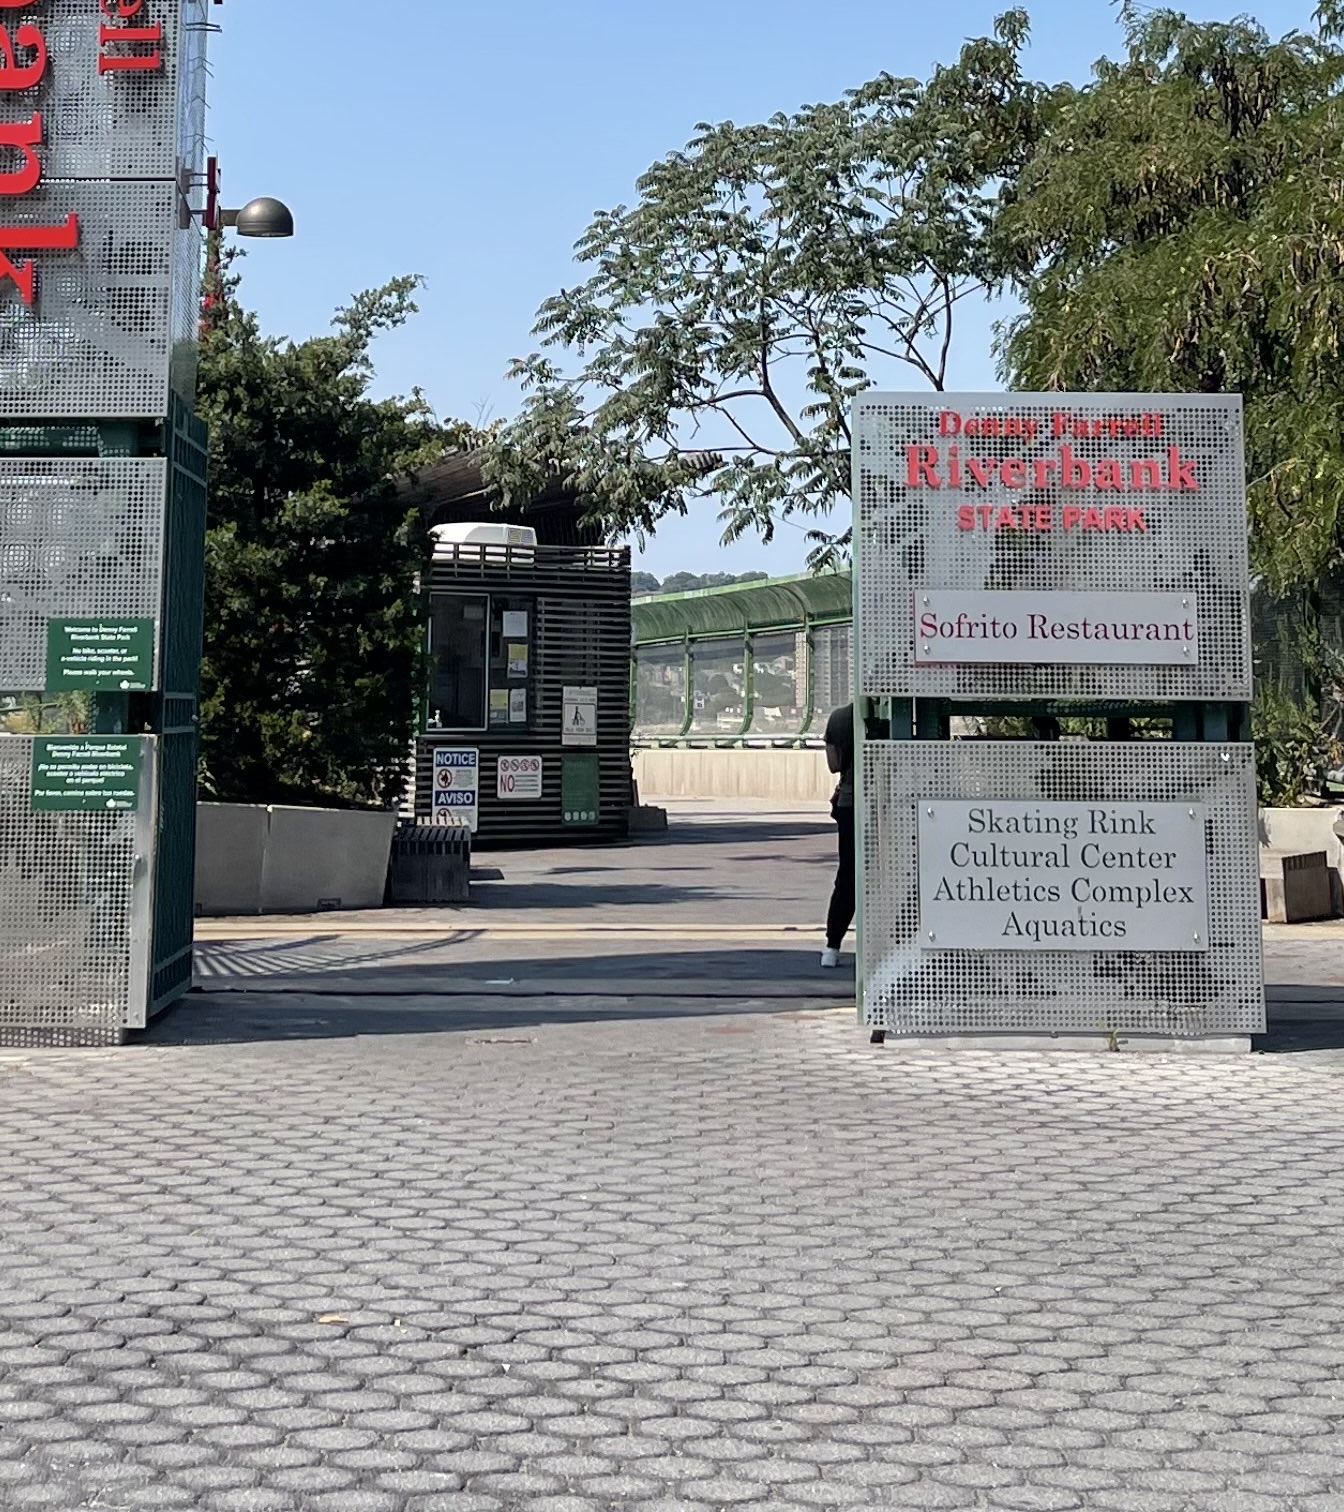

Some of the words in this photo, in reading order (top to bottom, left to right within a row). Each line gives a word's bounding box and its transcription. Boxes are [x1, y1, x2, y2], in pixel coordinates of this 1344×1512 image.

[939, 410, 1039, 440] Denny
[1051, 412, 1163, 437] Farrell
[902, 444, 1201, 489] Riverbank
[958, 505, 1052, 530] STATE
[1062, 505, 1148, 531] PARK
[920, 612, 1017, 639] Sofrito
[1027, 613, 1195, 641] Restaurant
[436, 753, 476, 765] NOTICE
[437, 792, 473, 804] AVISO
[500, 775, 515, 792] NO
[968, 808, 1080, 840] Skating
[1088, 809, 1157, 835] Rink
[950, 842, 1070, 869] Cultural
[1080, 843, 1178, 869] Center
[932, 876, 1061, 902] Athletics
[1071, 876, 1195, 909] Complex
[1001, 911, 1128, 942] Aquatics
